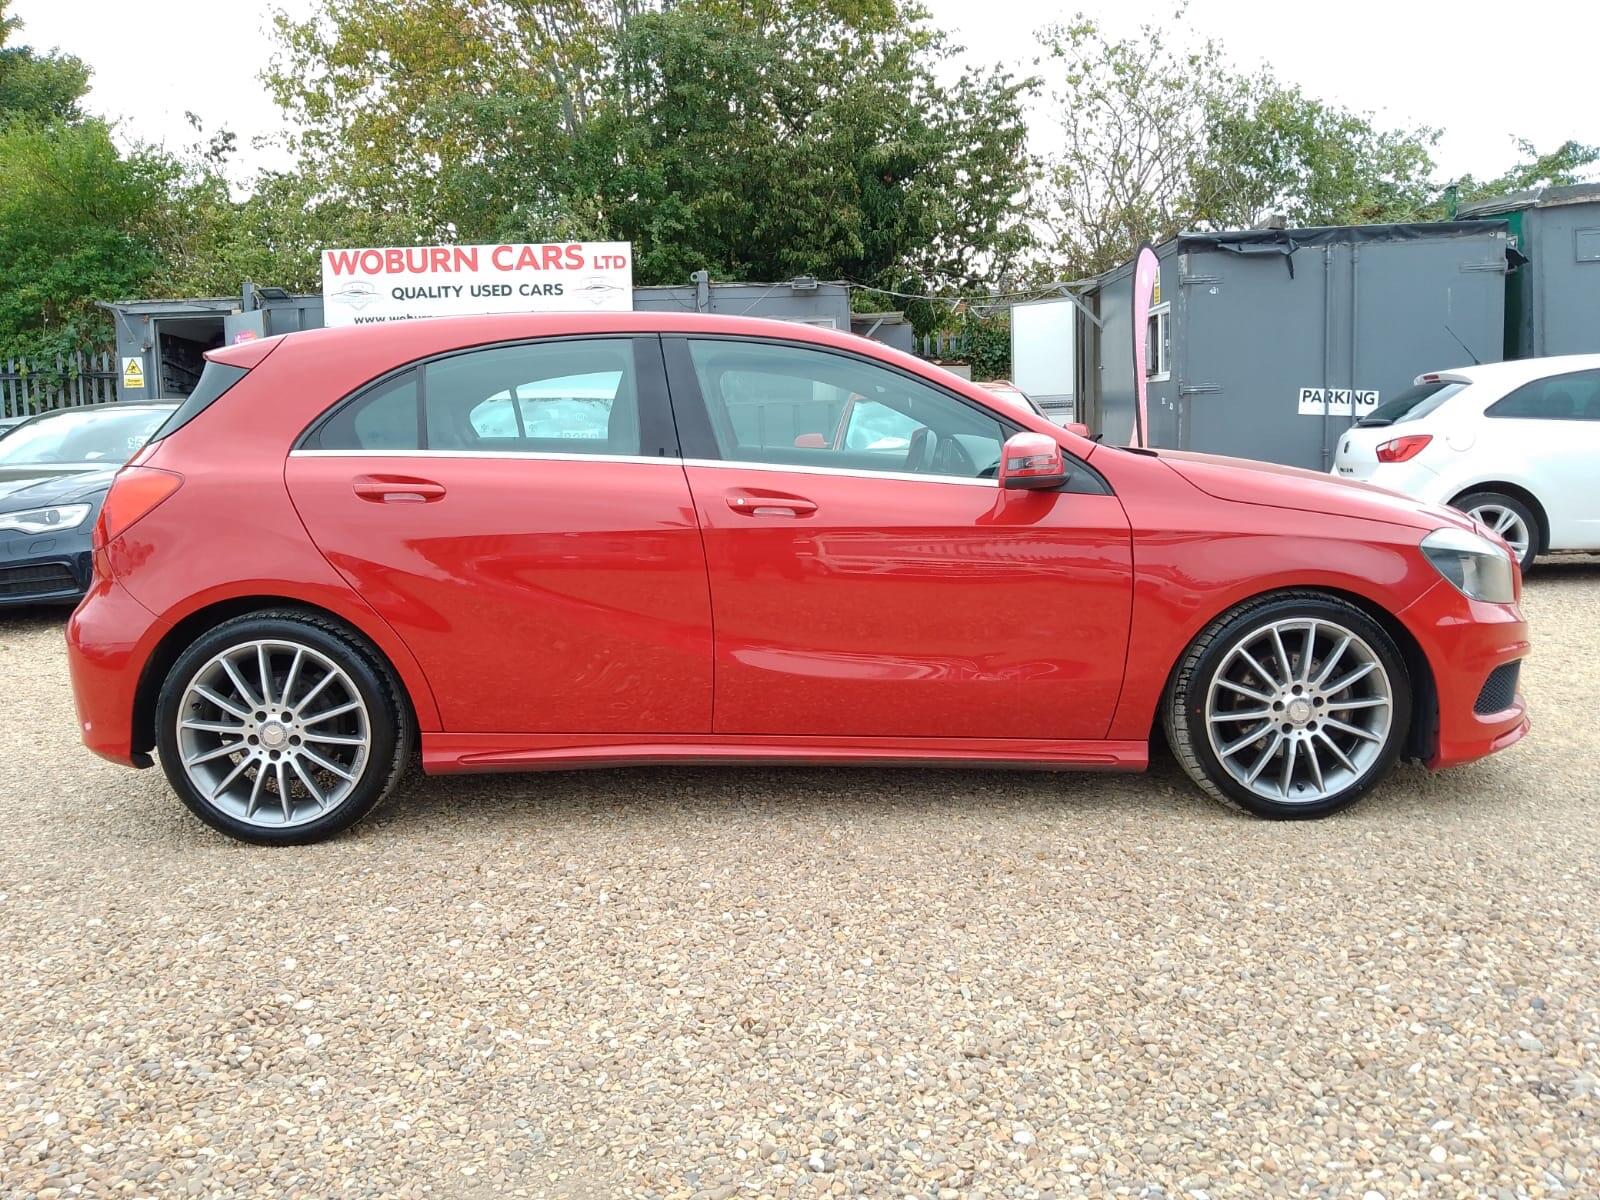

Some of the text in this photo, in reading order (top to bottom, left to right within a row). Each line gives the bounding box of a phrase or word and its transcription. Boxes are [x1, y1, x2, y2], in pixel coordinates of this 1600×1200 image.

[327, 244, 627, 276] WOBURN CARS LTD
[391, 283, 564, 300] QUALITY USED CARS
[1302, 389, 1375, 405] PARKING
